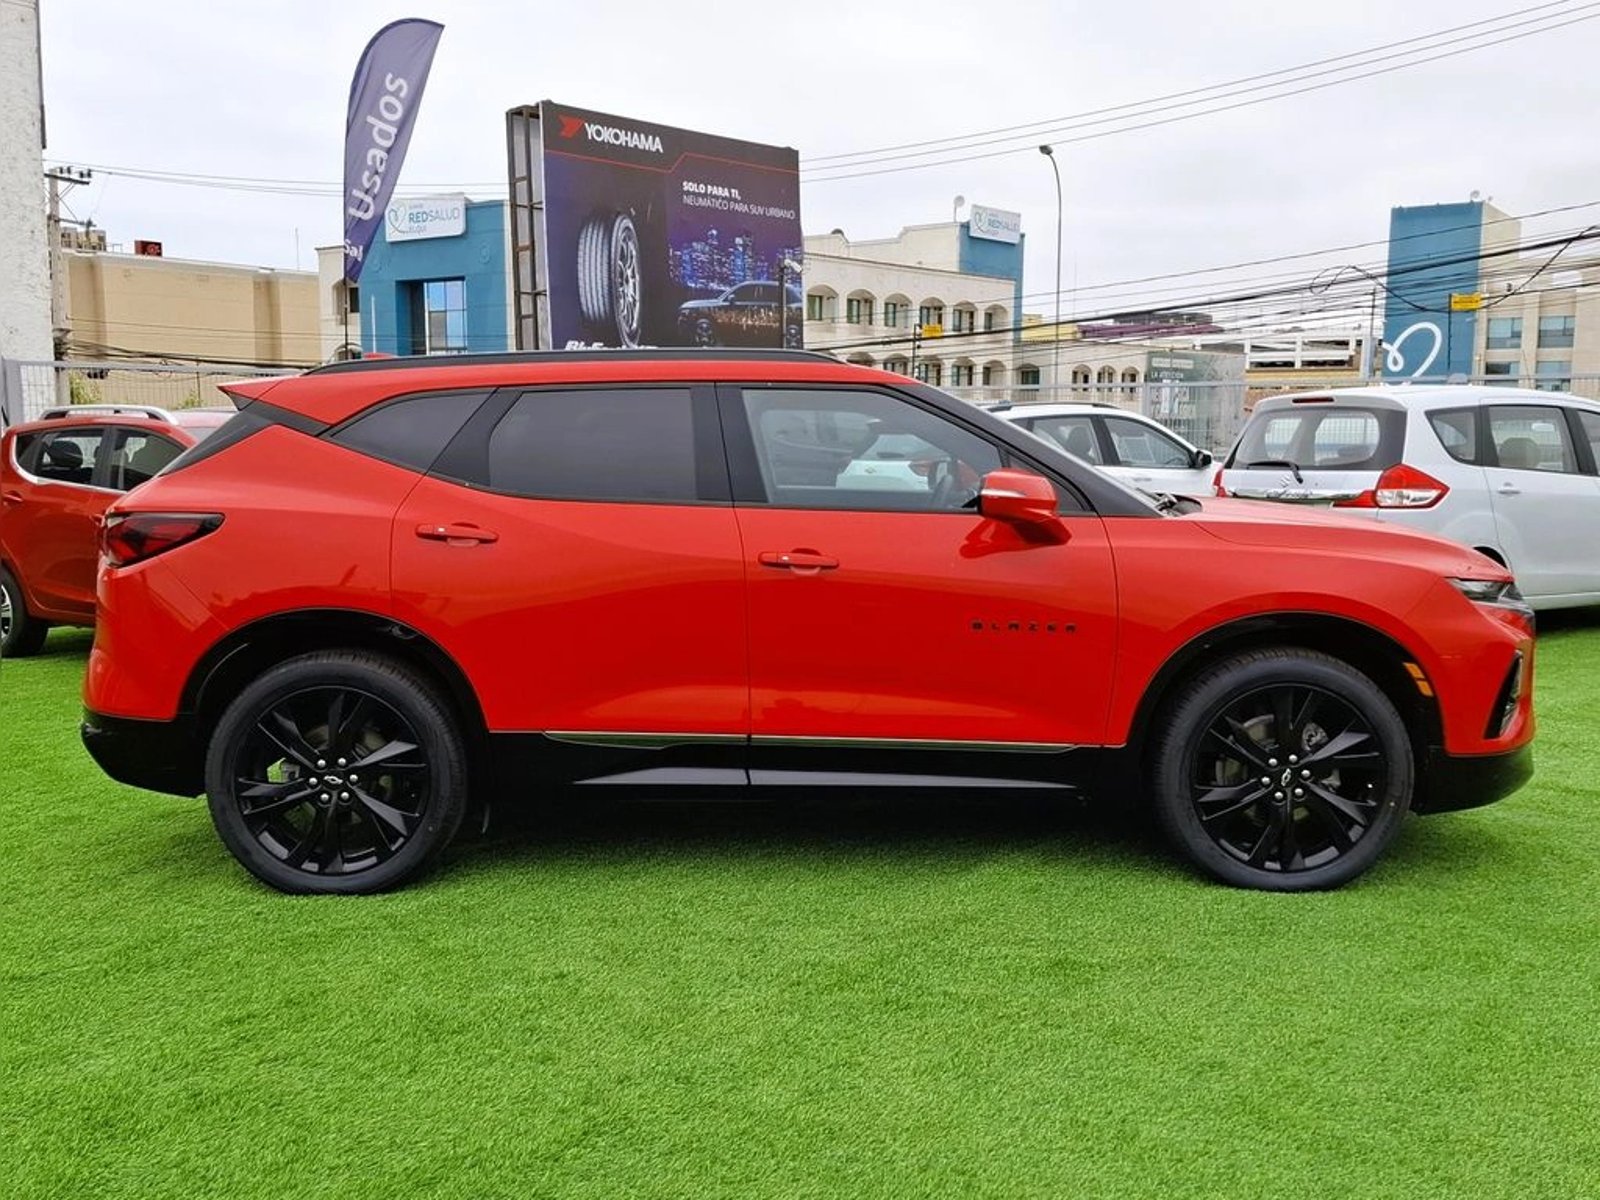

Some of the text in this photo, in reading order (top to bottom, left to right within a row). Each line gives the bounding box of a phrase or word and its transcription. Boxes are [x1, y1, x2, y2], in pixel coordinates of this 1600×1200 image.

[348, 72, 409, 221] Usados
[584, 122, 664, 154] YOKOHAMA
[682, 180, 742, 201] SOLO PARA TI,
[409, 208, 460, 223] REDSALUD
[729, 201, 750, 214] PARA
[749, 204, 766, 216] SUV
[765, 207, 796, 220] URBANO
[970, 620, 1078, 634] BLAZER
